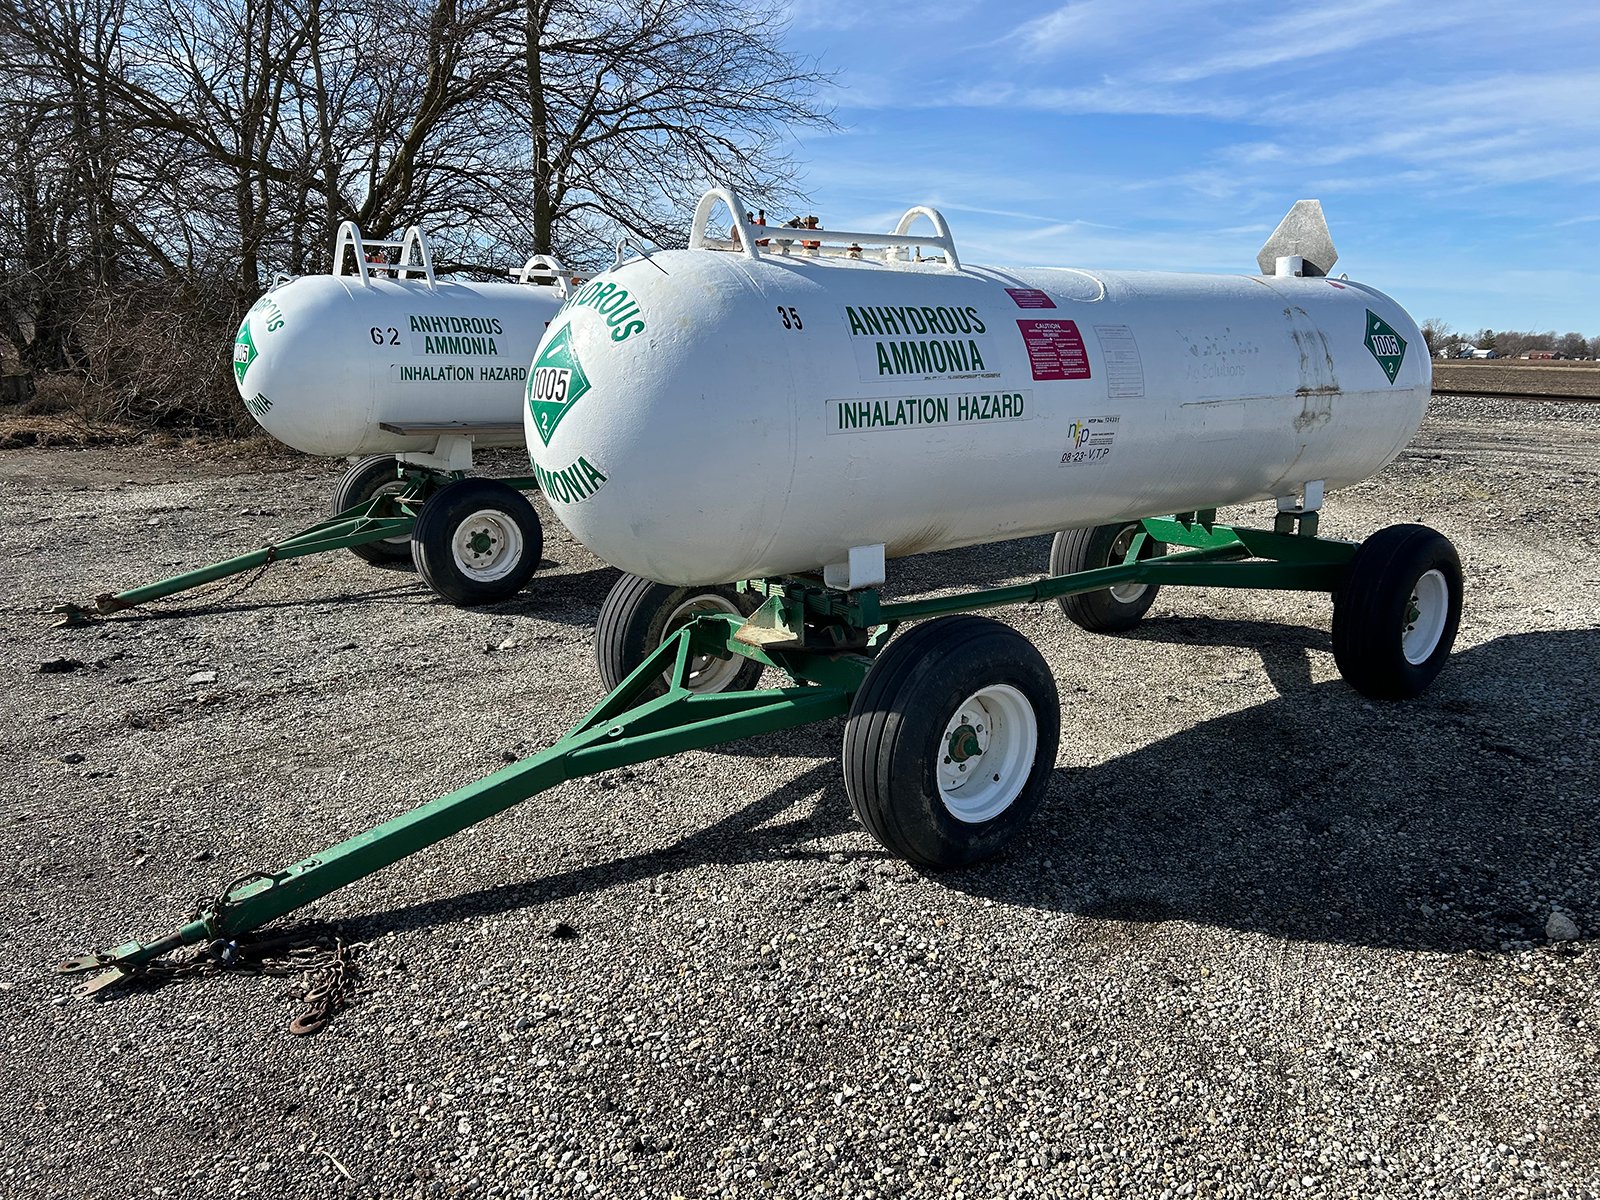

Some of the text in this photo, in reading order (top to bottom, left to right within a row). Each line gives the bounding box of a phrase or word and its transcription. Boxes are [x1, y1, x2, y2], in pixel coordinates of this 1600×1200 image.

[409, 315, 503, 335] ANHYDROUS
[777, 305, 804, 330] 35
[845, 306, 987, 336] ANHYDROUS
[1035, 322, 1061, 330] CAUTION
[425, 335, 498, 355] AMMONIA
[1372, 335, 1400, 355] 1005
[875, 339, 985, 376] AMMONIA
[1388, 362, 1394, 373] 2
[400, 366, 526, 381] INHALATION HAZARD
[533, 368, 568, 402] 1005
[541, 412, 548, 430] 2
[838, 393, 1024, 429] INHALATION HAZARD
[1068, 419, 1090, 449] ntip
